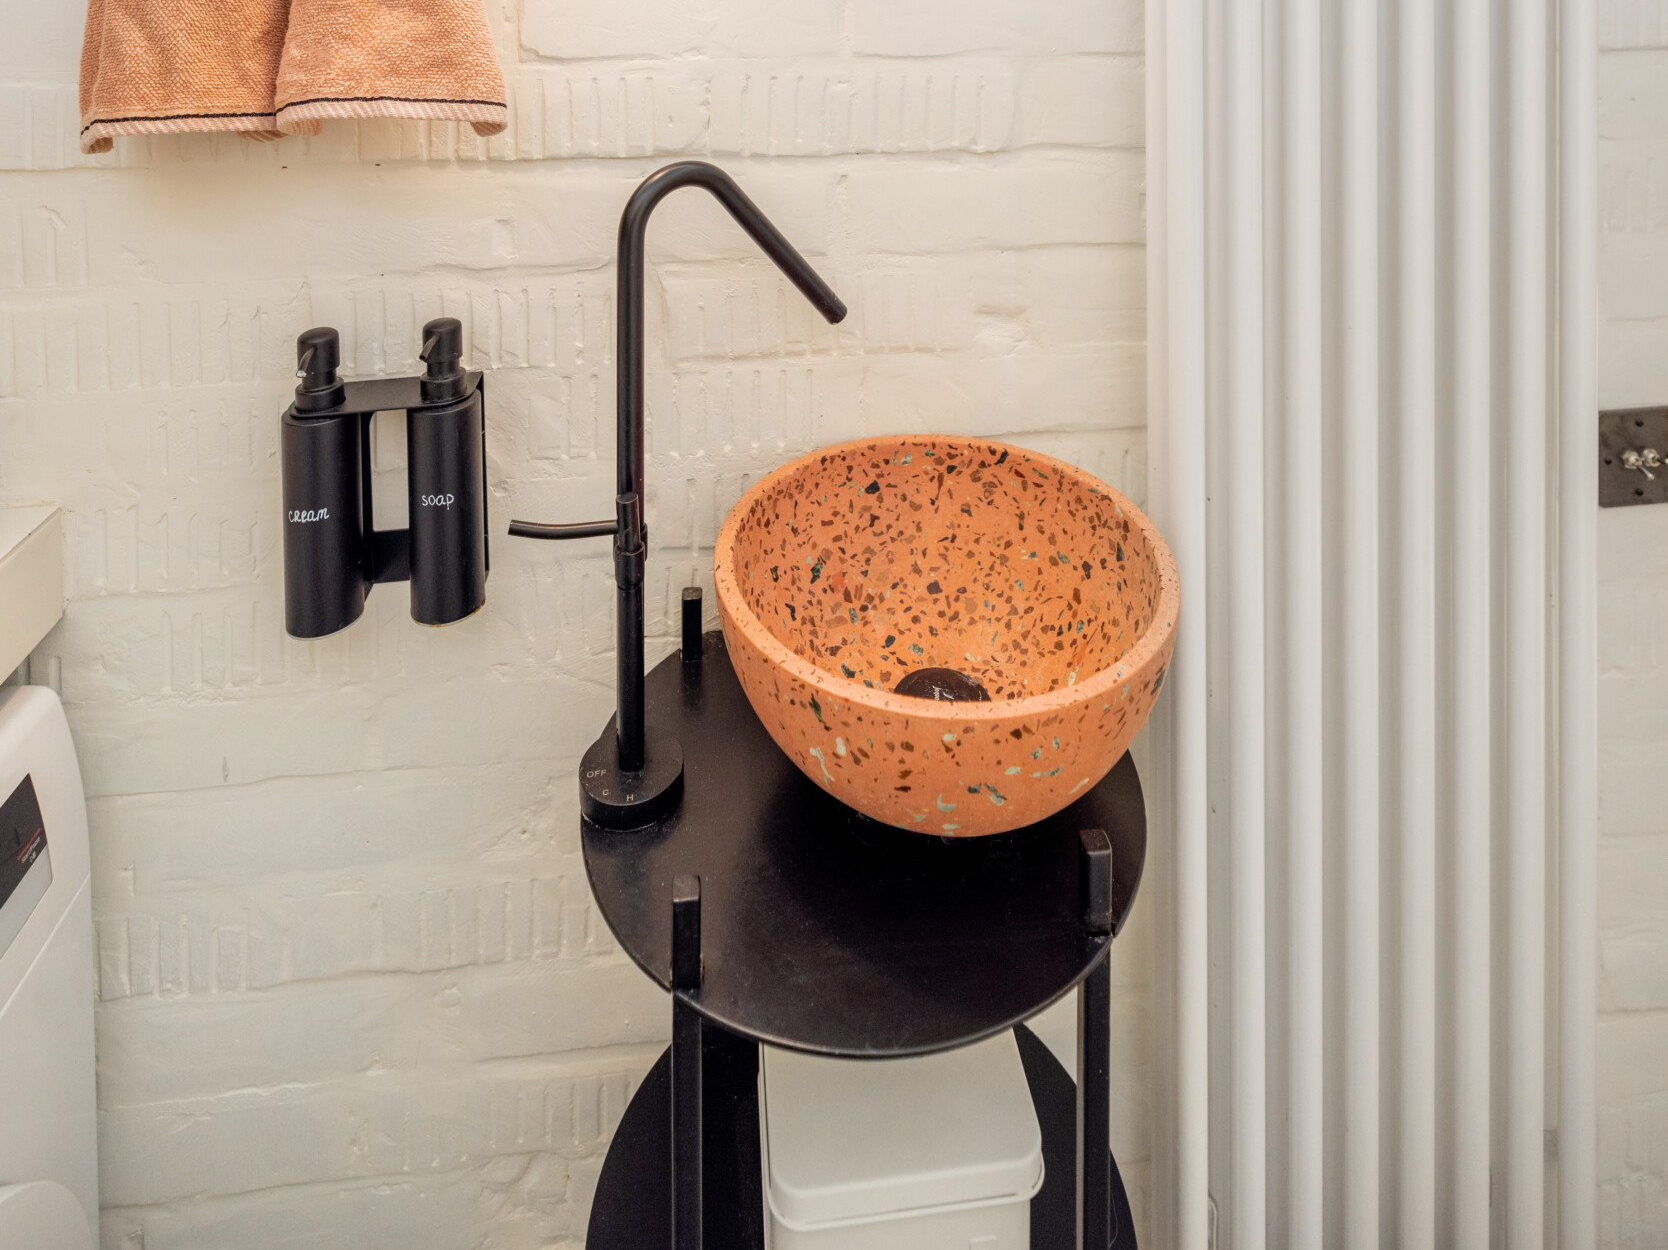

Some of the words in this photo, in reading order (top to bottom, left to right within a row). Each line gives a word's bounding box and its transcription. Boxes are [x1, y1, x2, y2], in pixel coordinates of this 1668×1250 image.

[421, 493, 455, 511] soap
[586, 769, 607, 778] OFF
[626, 793, 634, 802] H
